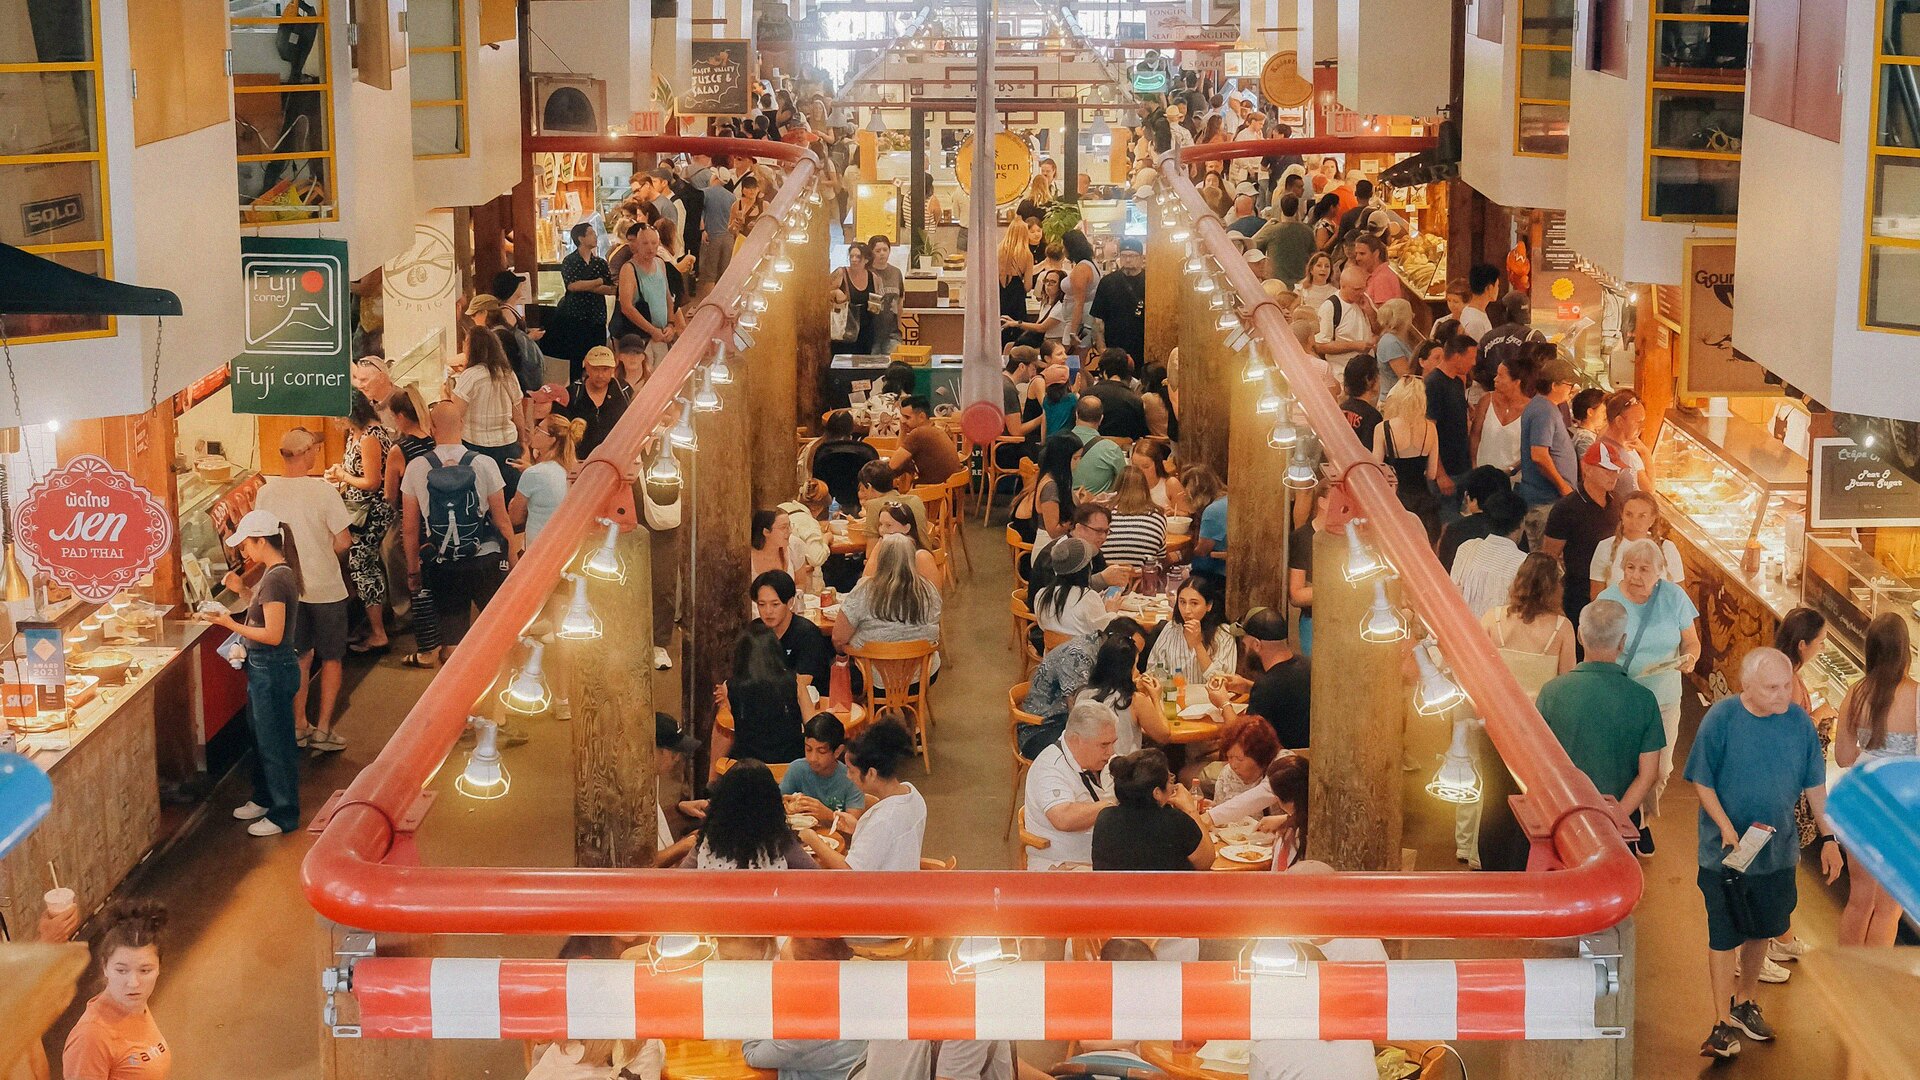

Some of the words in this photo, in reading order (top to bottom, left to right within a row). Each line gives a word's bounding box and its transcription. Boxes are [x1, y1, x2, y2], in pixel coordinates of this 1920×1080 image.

[691, 74, 723, 86] JUICE
[691, 84, 720, 98] SALAD
[634, 111, 660, 131] EXIT
[27, 202, 79, 226] SOLO
[253, 269, 297, 307] Fuji
[253, 293, 287, 302] corner
[395, 299, 443, 312] SPRIG
[236, 365, 275, 400] Fuji
[283, 372, 345, 386] corner
[1844, 478, 1875, 491] Brown
[1876, 478, 1903, 490] Sugar
[65, 490, 110, 508] ผัดไทย
[48, 511, 128, 542] sen
[61, 548, 88, 558] PAD
[90, 548, 124, 559] THAI
